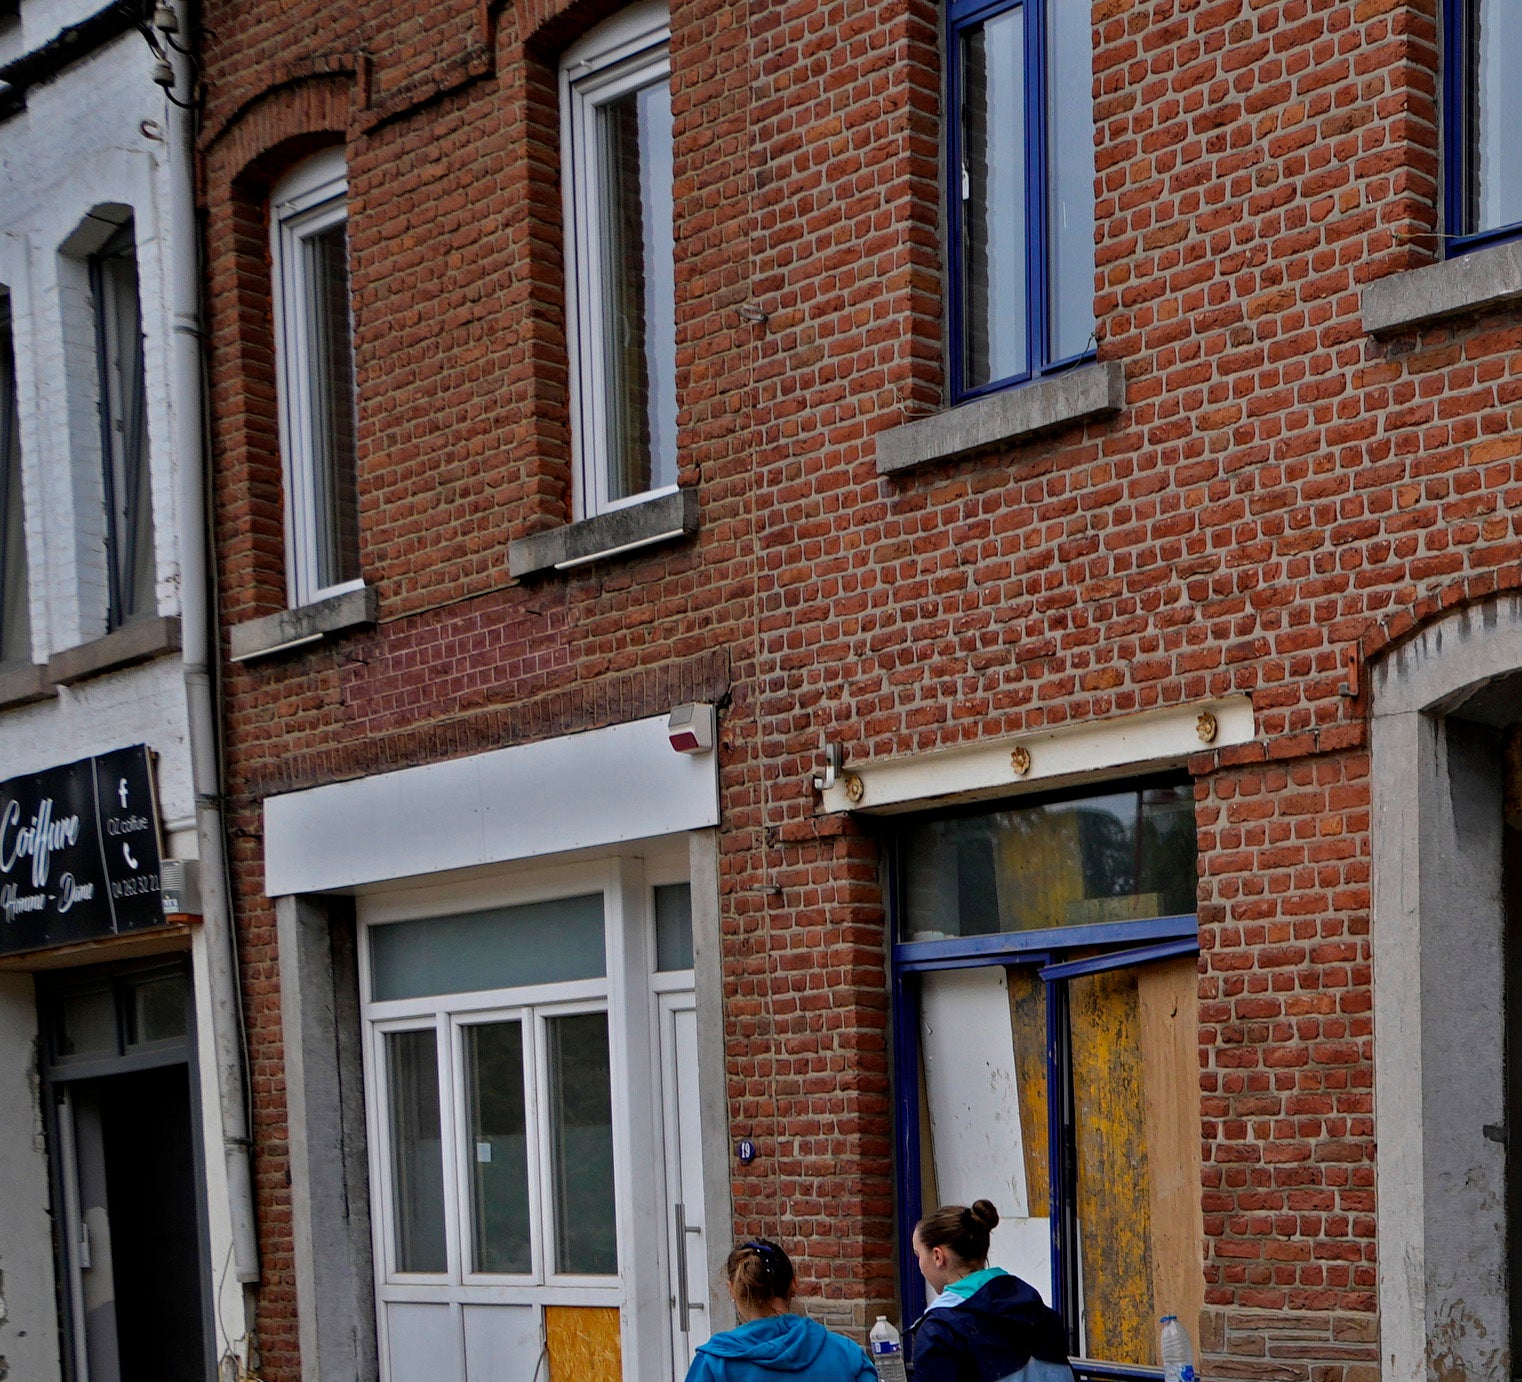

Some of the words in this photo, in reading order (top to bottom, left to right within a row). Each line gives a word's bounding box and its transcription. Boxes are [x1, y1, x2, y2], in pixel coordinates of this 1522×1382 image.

[0, 797, 79, 888] Coiffure
[0, 882, 46, 923] Homme
[57, 872, 94, 913] Dame
[741, 1142, 750, 1158] 19
